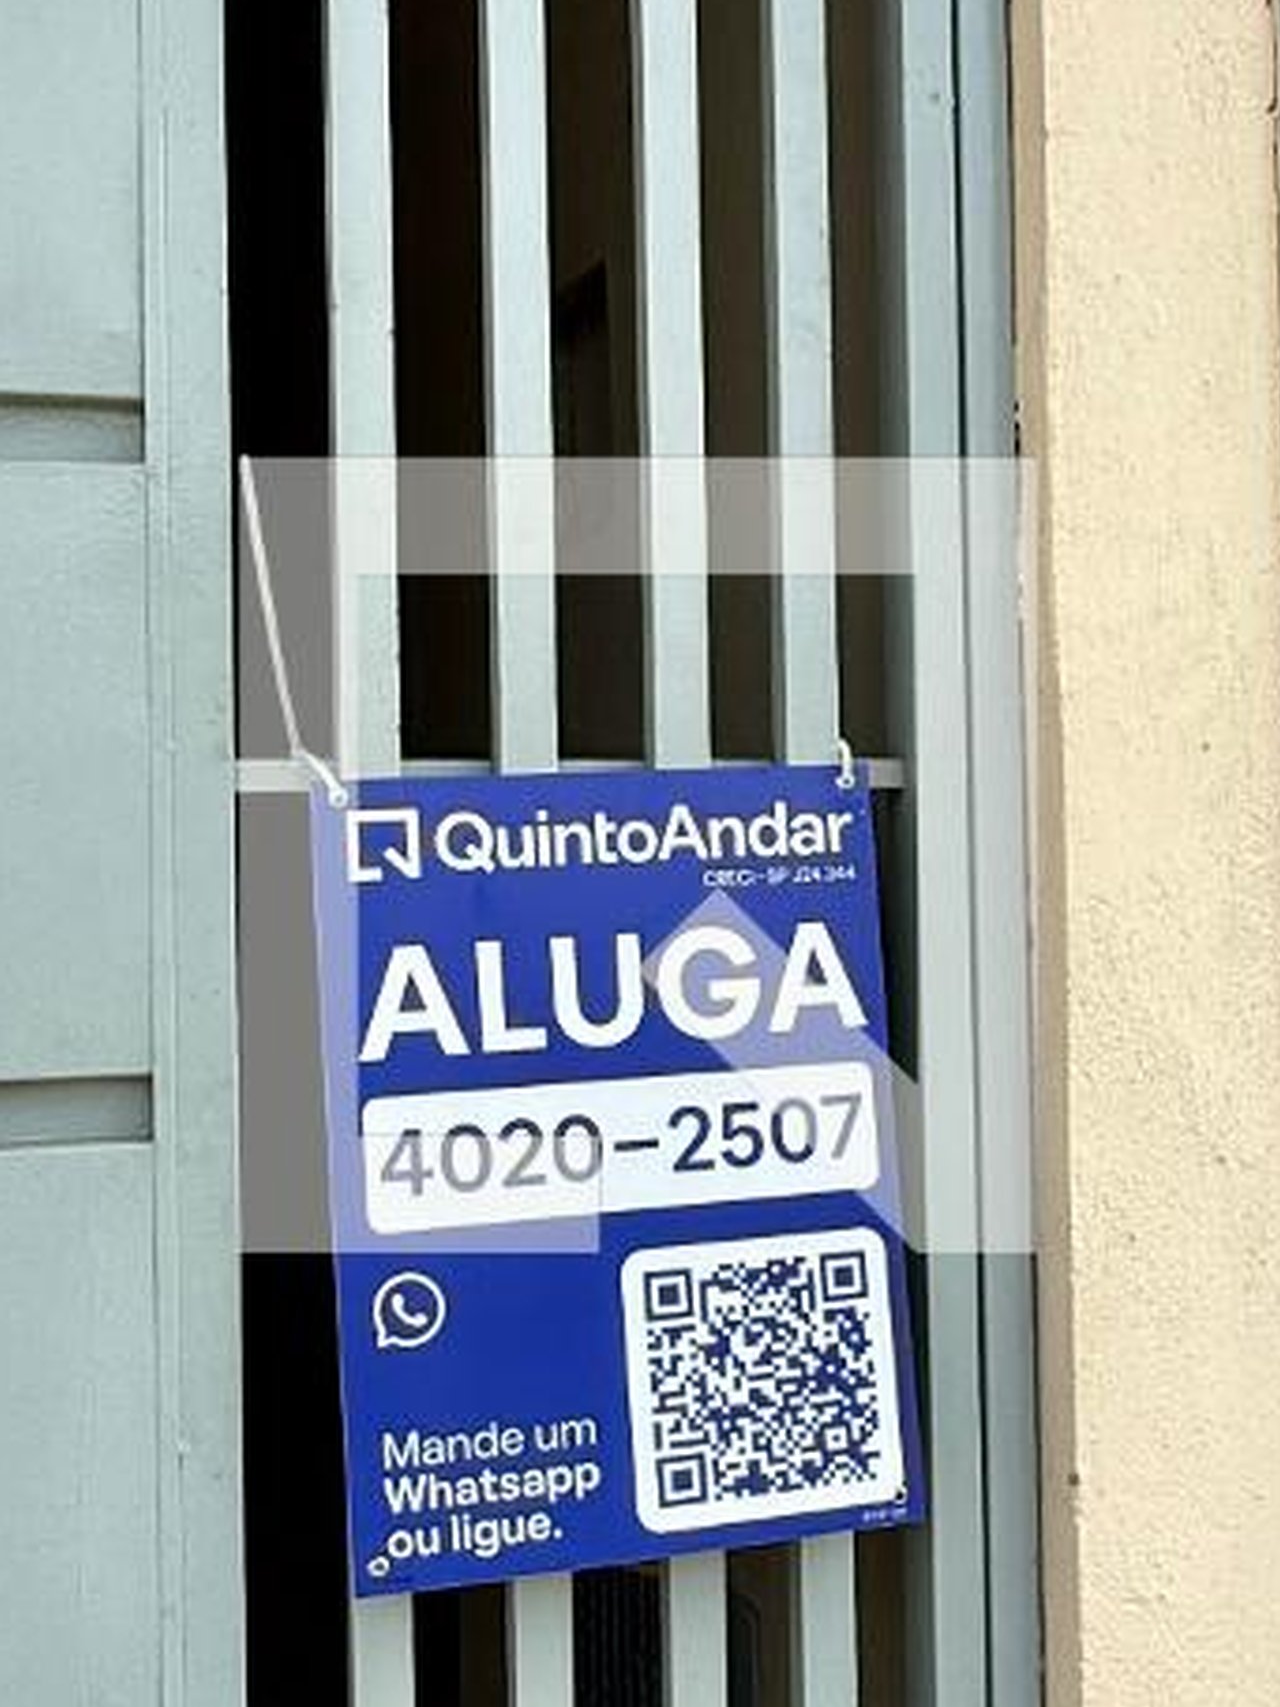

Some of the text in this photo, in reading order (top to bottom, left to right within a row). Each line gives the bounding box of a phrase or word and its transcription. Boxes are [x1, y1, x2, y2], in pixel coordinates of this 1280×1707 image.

[434, 800, 854, 873] QuintoAndar
[357, 920, 869, 1063] ALUGA
[379, 1091, 863, 1196] 4020-2507
[382, 1417, 598, 1471] Mande um
[383, 1461, 602, 1514] Whatsapp
[387, 1511, 563, 1558] ou ligue.
